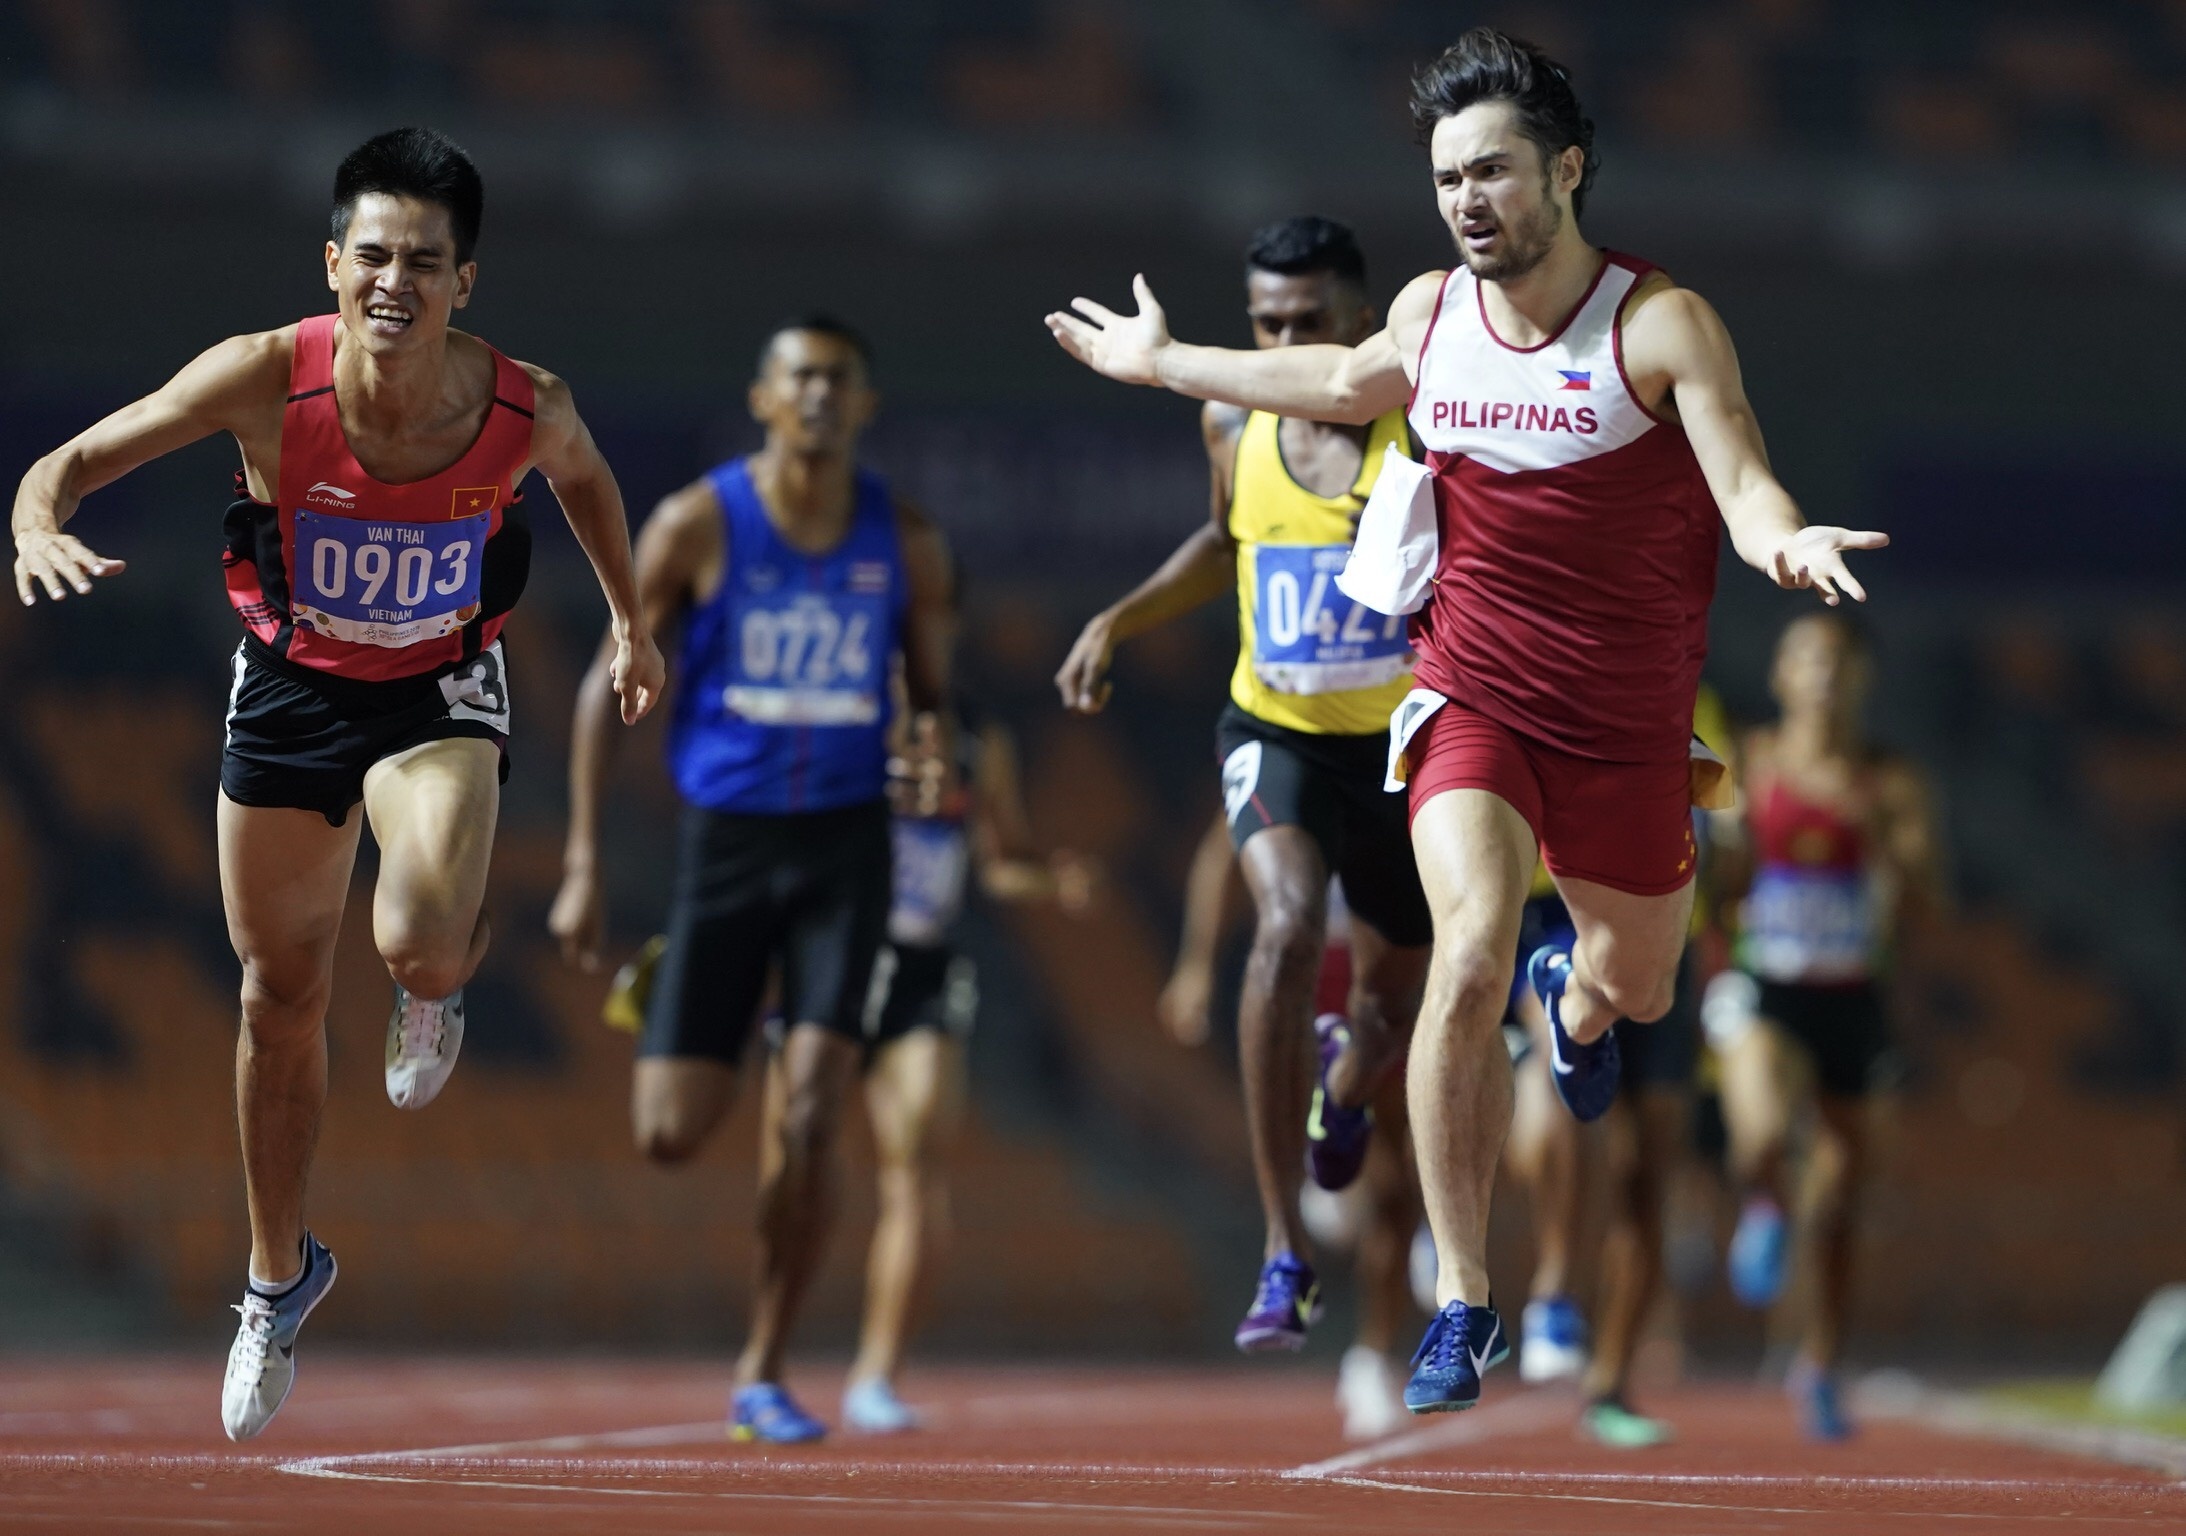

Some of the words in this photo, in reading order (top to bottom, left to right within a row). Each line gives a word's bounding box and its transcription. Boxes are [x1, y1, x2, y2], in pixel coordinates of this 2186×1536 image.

[1433, 401, 1598, 435] PILIPINAS
[306, 494, 356, 509] LI-NING
[367, 527, 394, 543] VAN
[396, 529, 425, 544] THAI
[312, 537, 471, 606] 0903
[368, 608, 412, 622] VIETNAM
